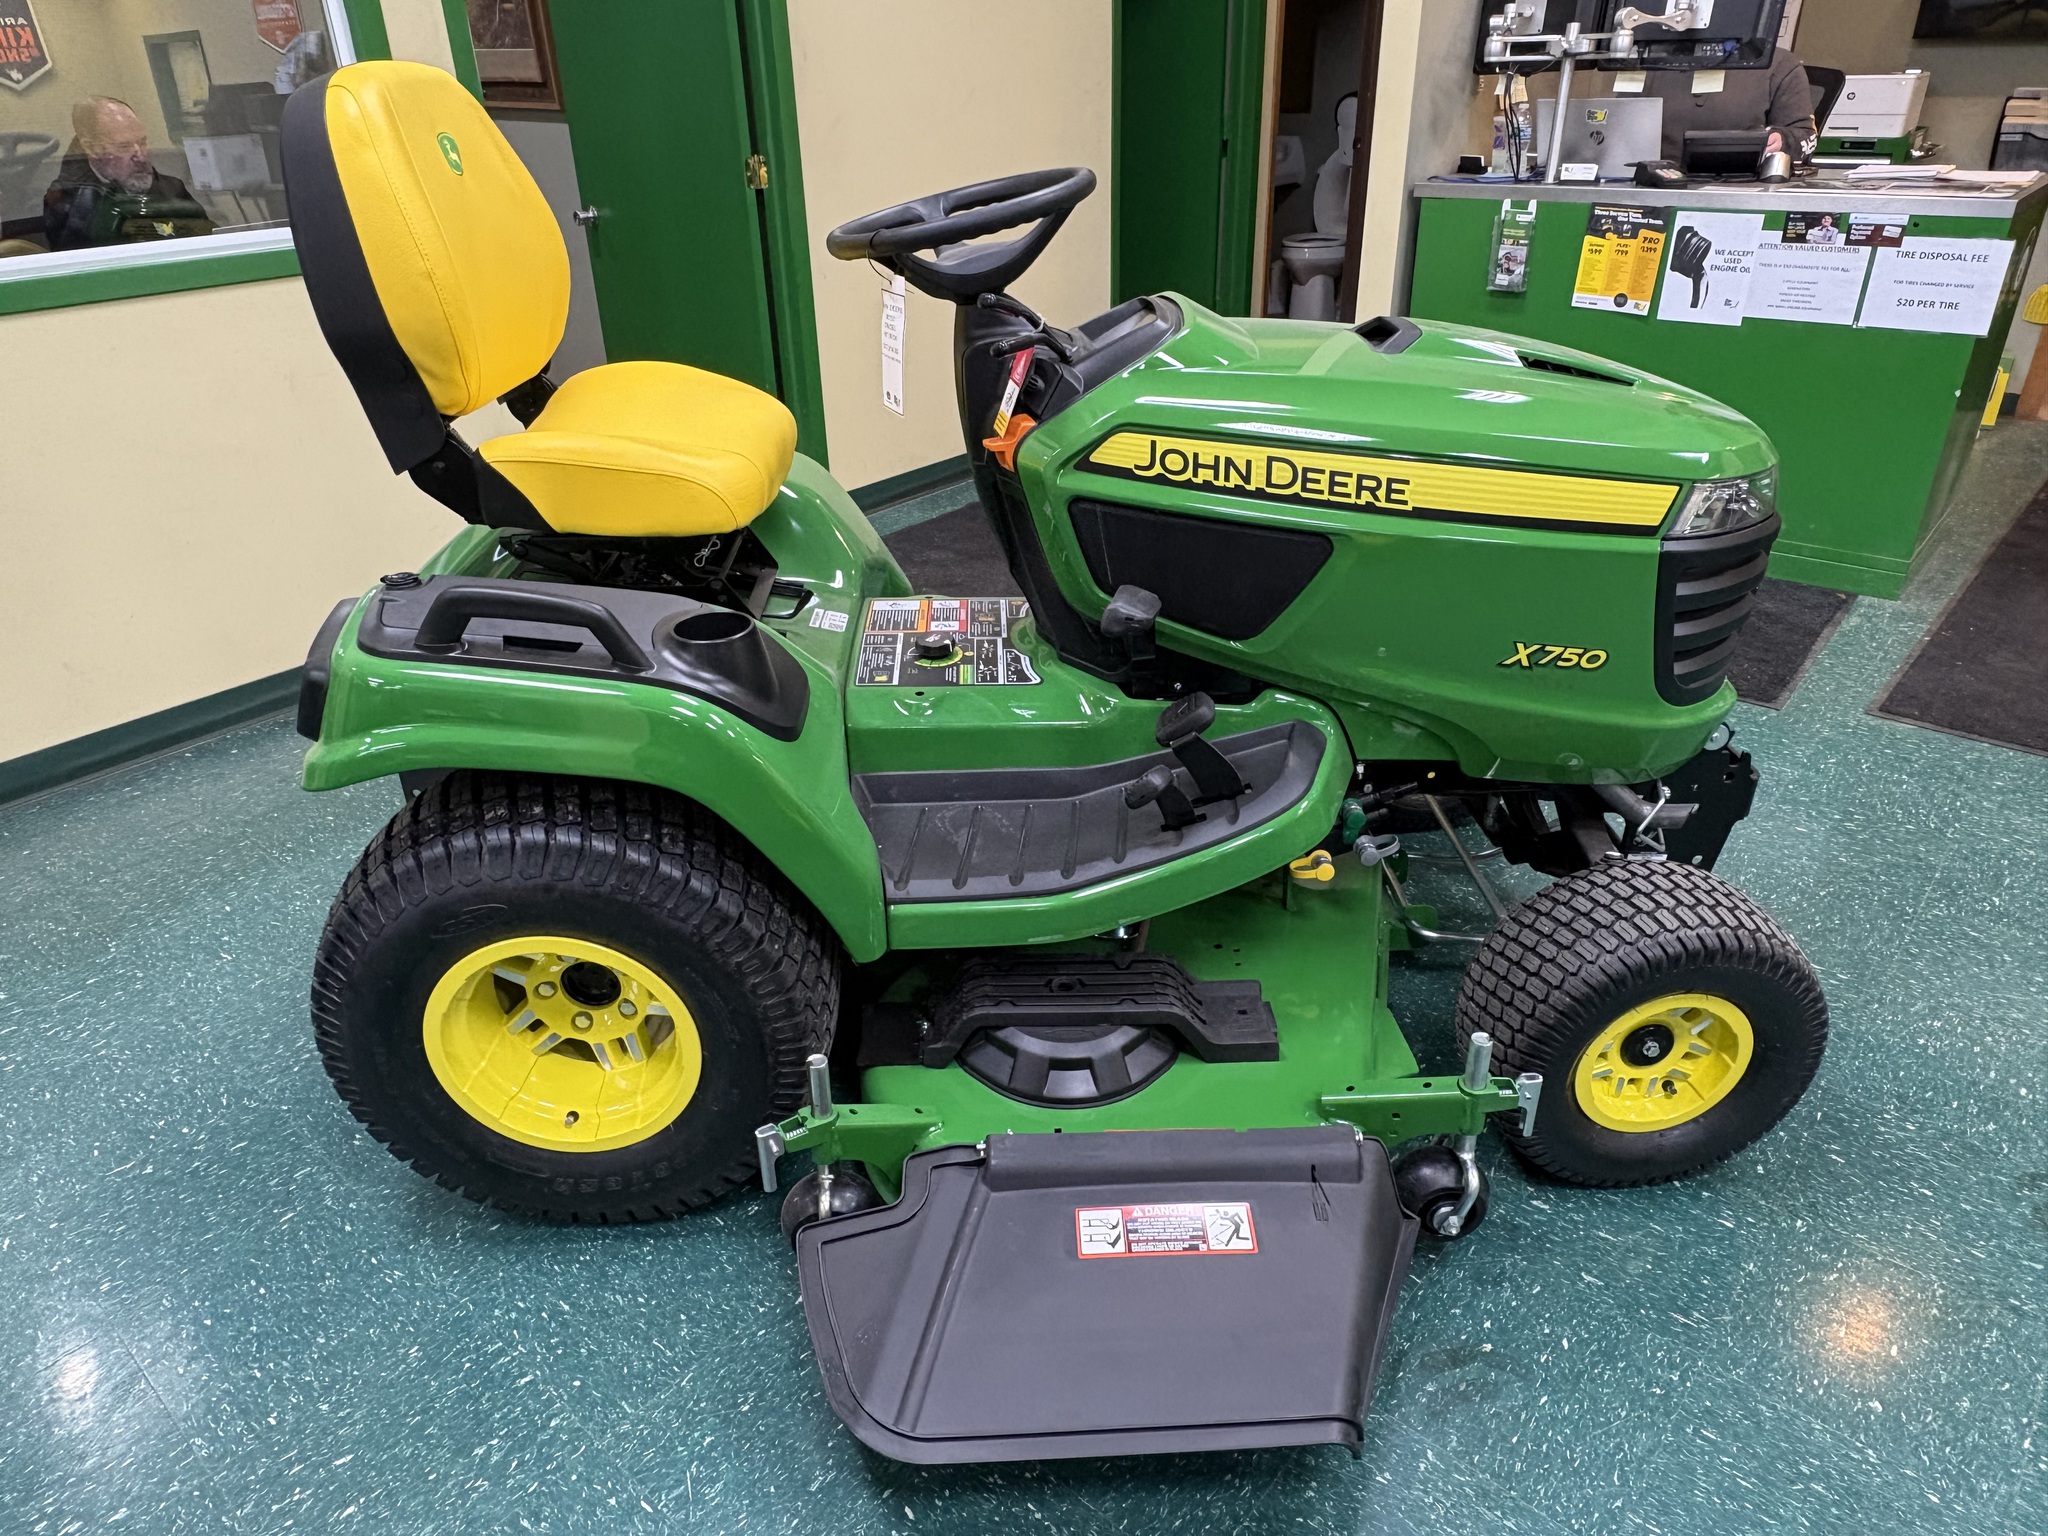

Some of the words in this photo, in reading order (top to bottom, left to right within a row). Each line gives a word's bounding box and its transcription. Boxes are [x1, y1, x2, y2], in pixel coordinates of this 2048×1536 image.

[1642, 236, 1660, 245] PRO
[1758, 243, 1793, 251] ATTENTION
[1820, 245, 1860, 254] CUSTOMERS
[1896, 250, 1917, 259] TIRE
[1919, 252, 1968, 262] DISPOSAL
[1970, 254, 1989, 263] FEE
[1710, 264, 1737, 272] ENGINE
[1896, 297, 1914, 307] $20
[1916, 300, 1936, 309] PER
[1938, 301, 1960, 311] TIRE
[1133, 439, 1254, 487] JOHN
[1265, 455, 1412, 507] DEERE
[1499, 641, 1608, 669] X750
[1145, 1206, 1194, 1216] DANGER
